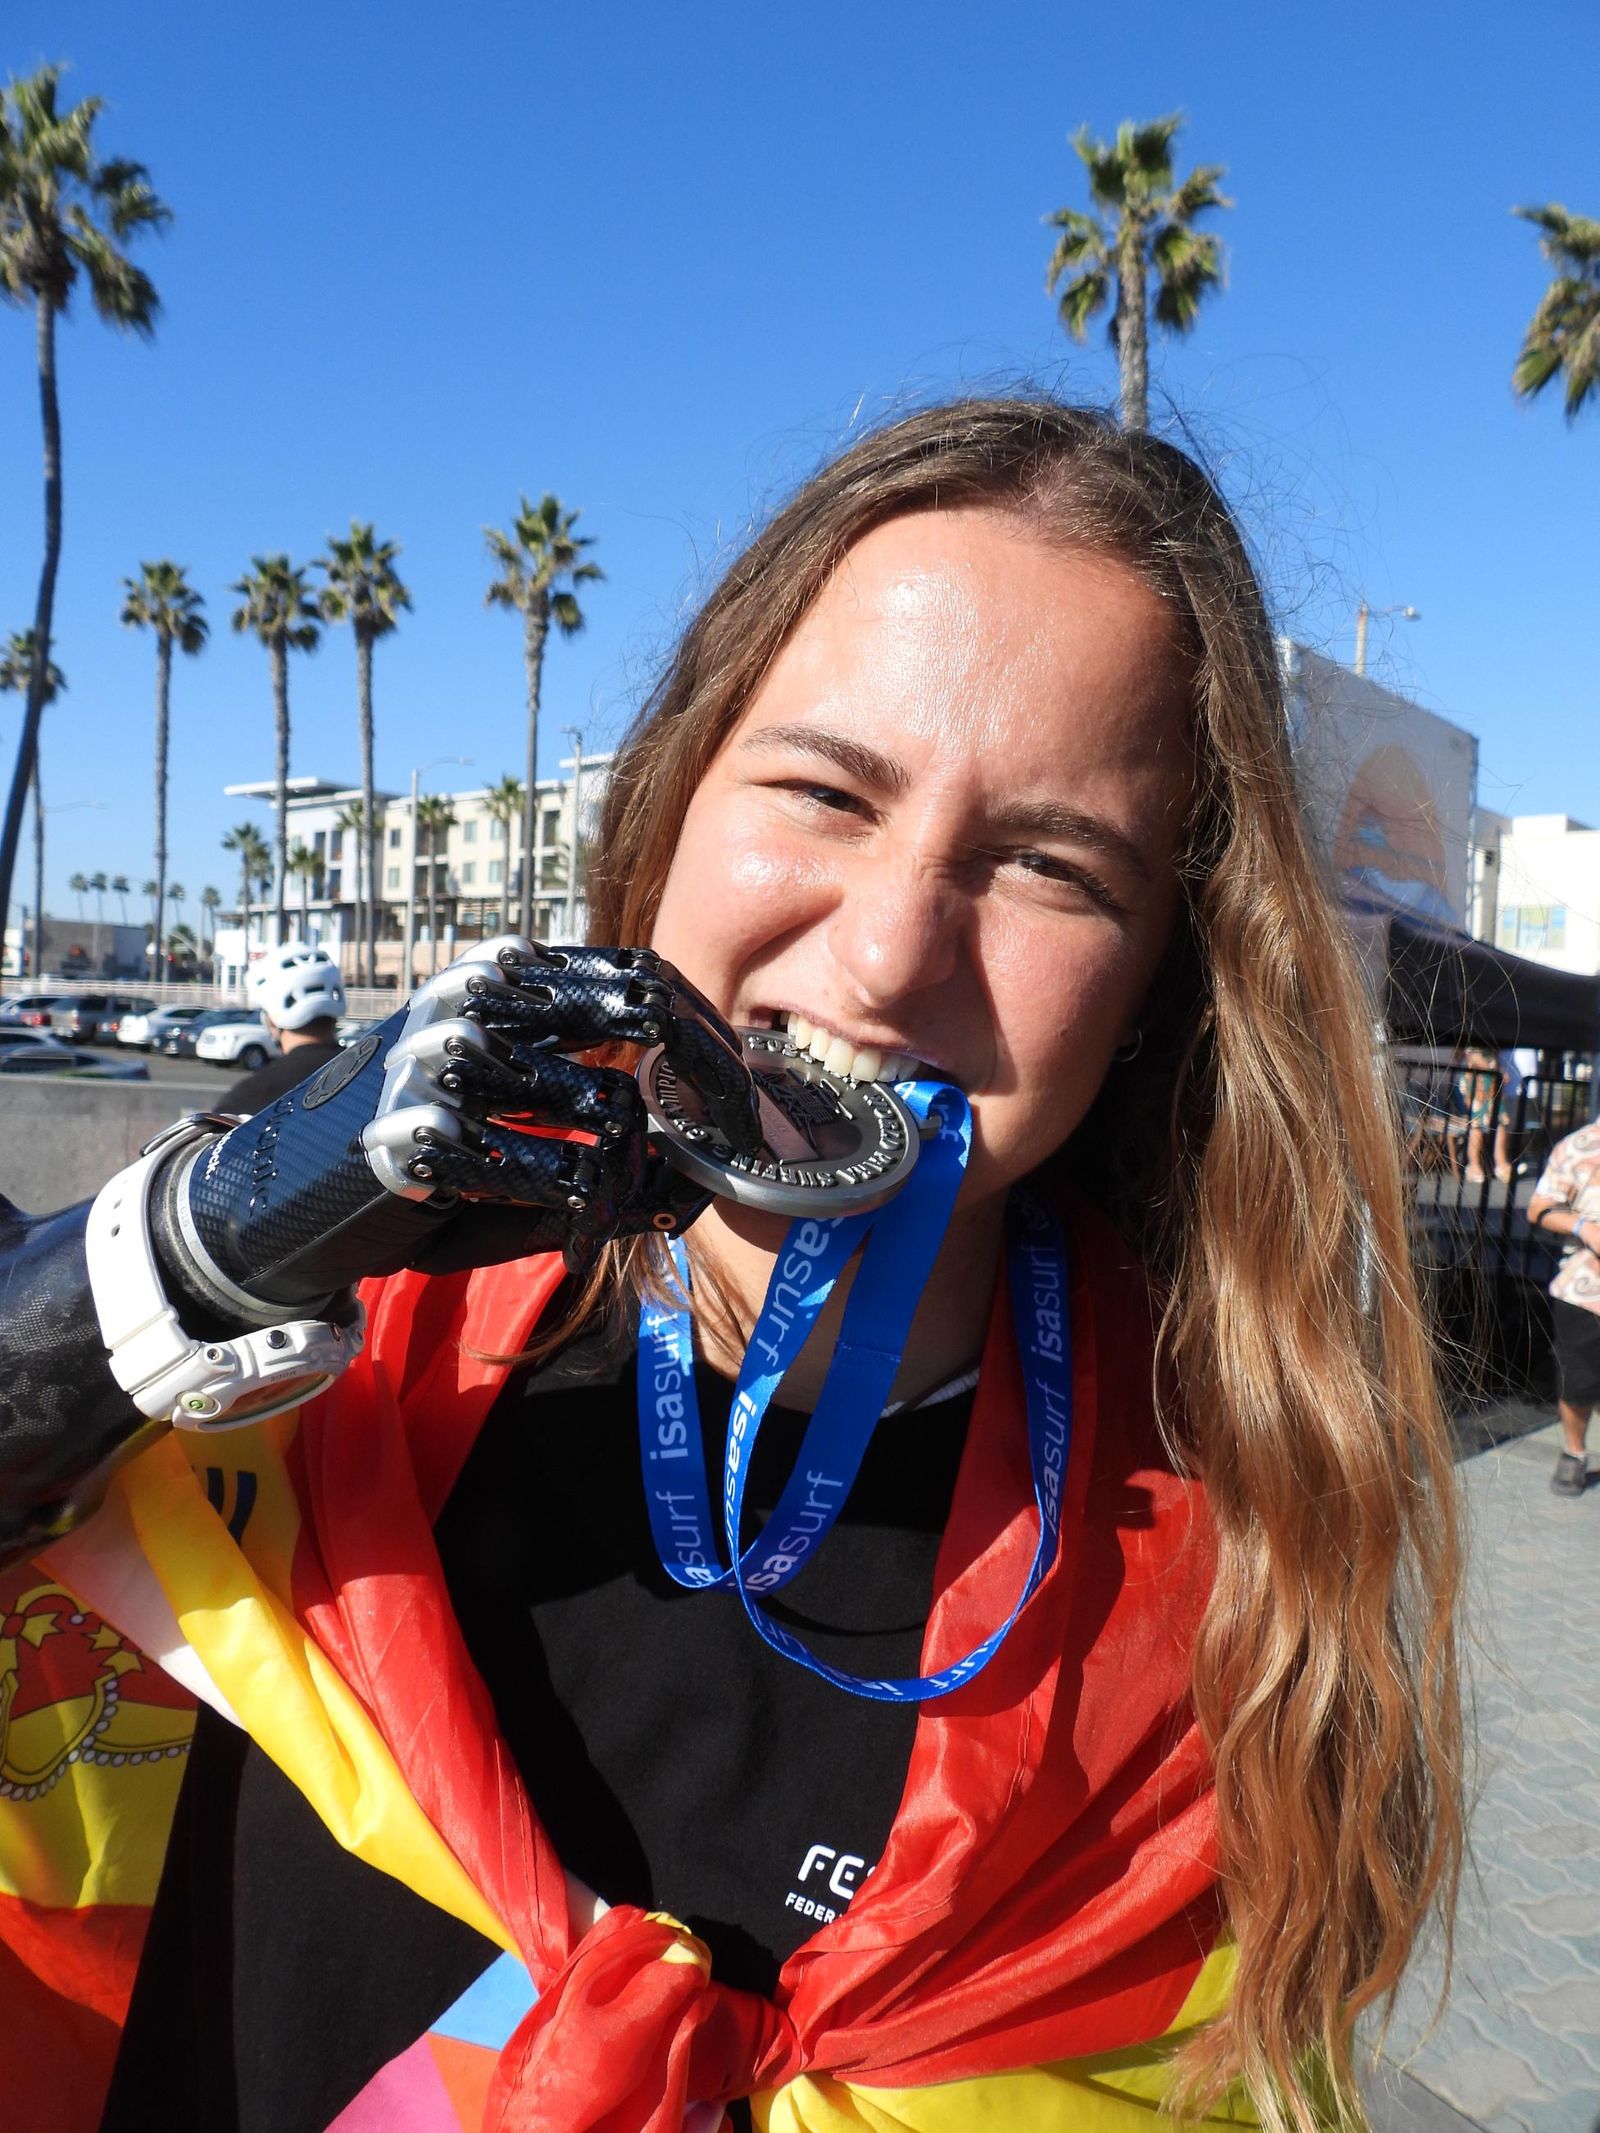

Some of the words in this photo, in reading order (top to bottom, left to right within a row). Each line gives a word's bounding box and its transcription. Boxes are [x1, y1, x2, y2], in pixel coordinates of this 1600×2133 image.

[757, 1216, 844, 1367] asurf
[1021, 1240, 1063, 1364] isasurf
[647, 1310, 690, 1461] isasurf
[1034, 1378, 1066, 1536] isasurf
[655, 1490, 716, 1588] asurf
[728, 1470, 844, 1594] isasurf
[784, 1891, 843, 1925] FEDER
[797, 1843, 877, 1900] FE
